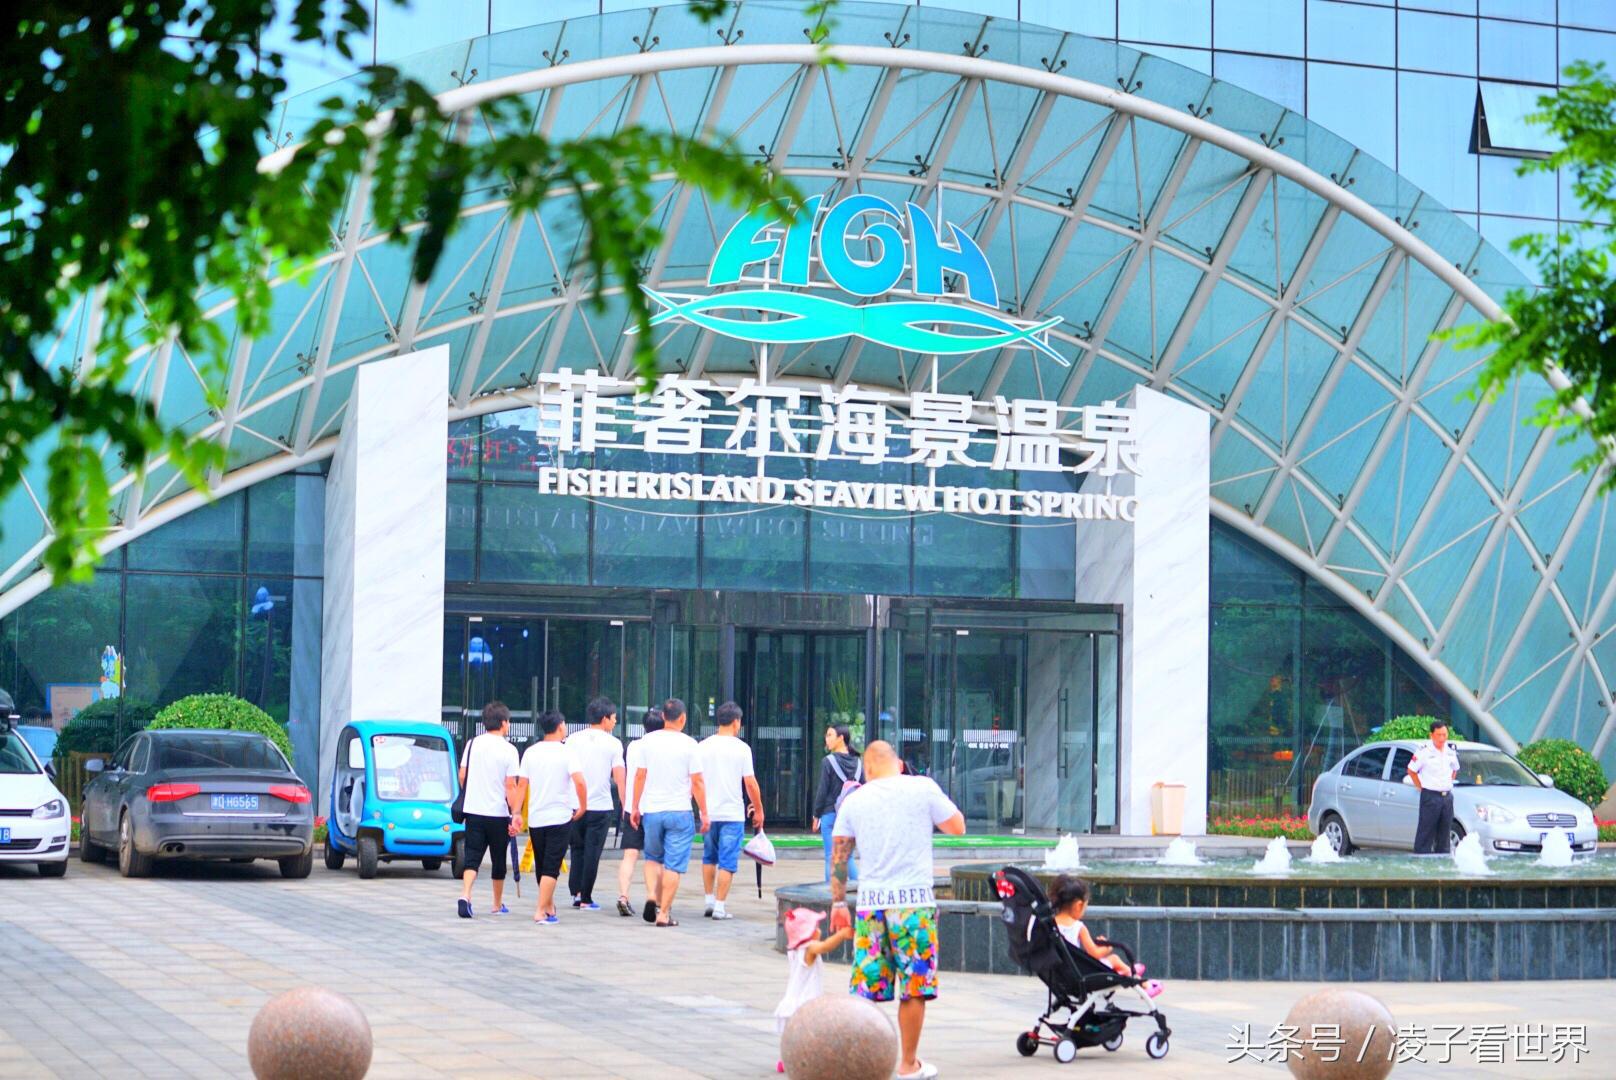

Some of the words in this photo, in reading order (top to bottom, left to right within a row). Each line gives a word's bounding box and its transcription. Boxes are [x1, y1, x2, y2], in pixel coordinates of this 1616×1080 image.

[536, 366, 1143, 477] 菲奢尔海景温泉
[794, 477, 936, 512] SEAVIEW
[943, 485, 1013, 516] HOT
